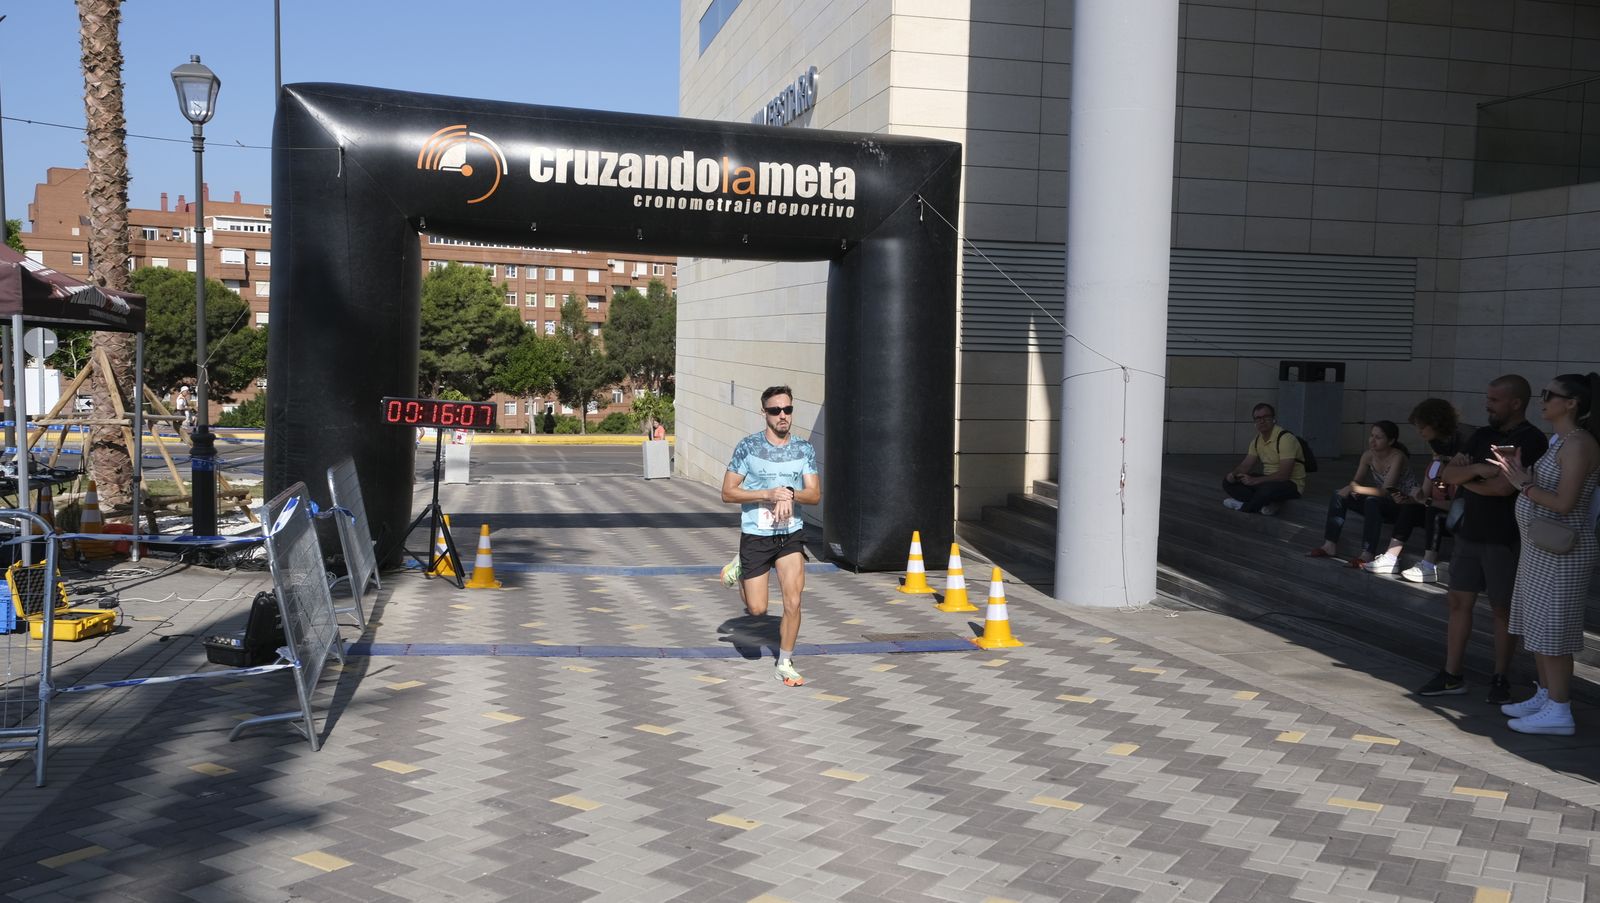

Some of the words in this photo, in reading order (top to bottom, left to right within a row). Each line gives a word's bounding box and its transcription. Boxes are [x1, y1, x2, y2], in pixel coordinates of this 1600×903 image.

[529, 147, 856, 200] cruzandolameta
[633, 194, 762, 215] cronometraje
[766, 200, 855, 218] deportivo
[387, 401, 492, 425] 00:16:07
